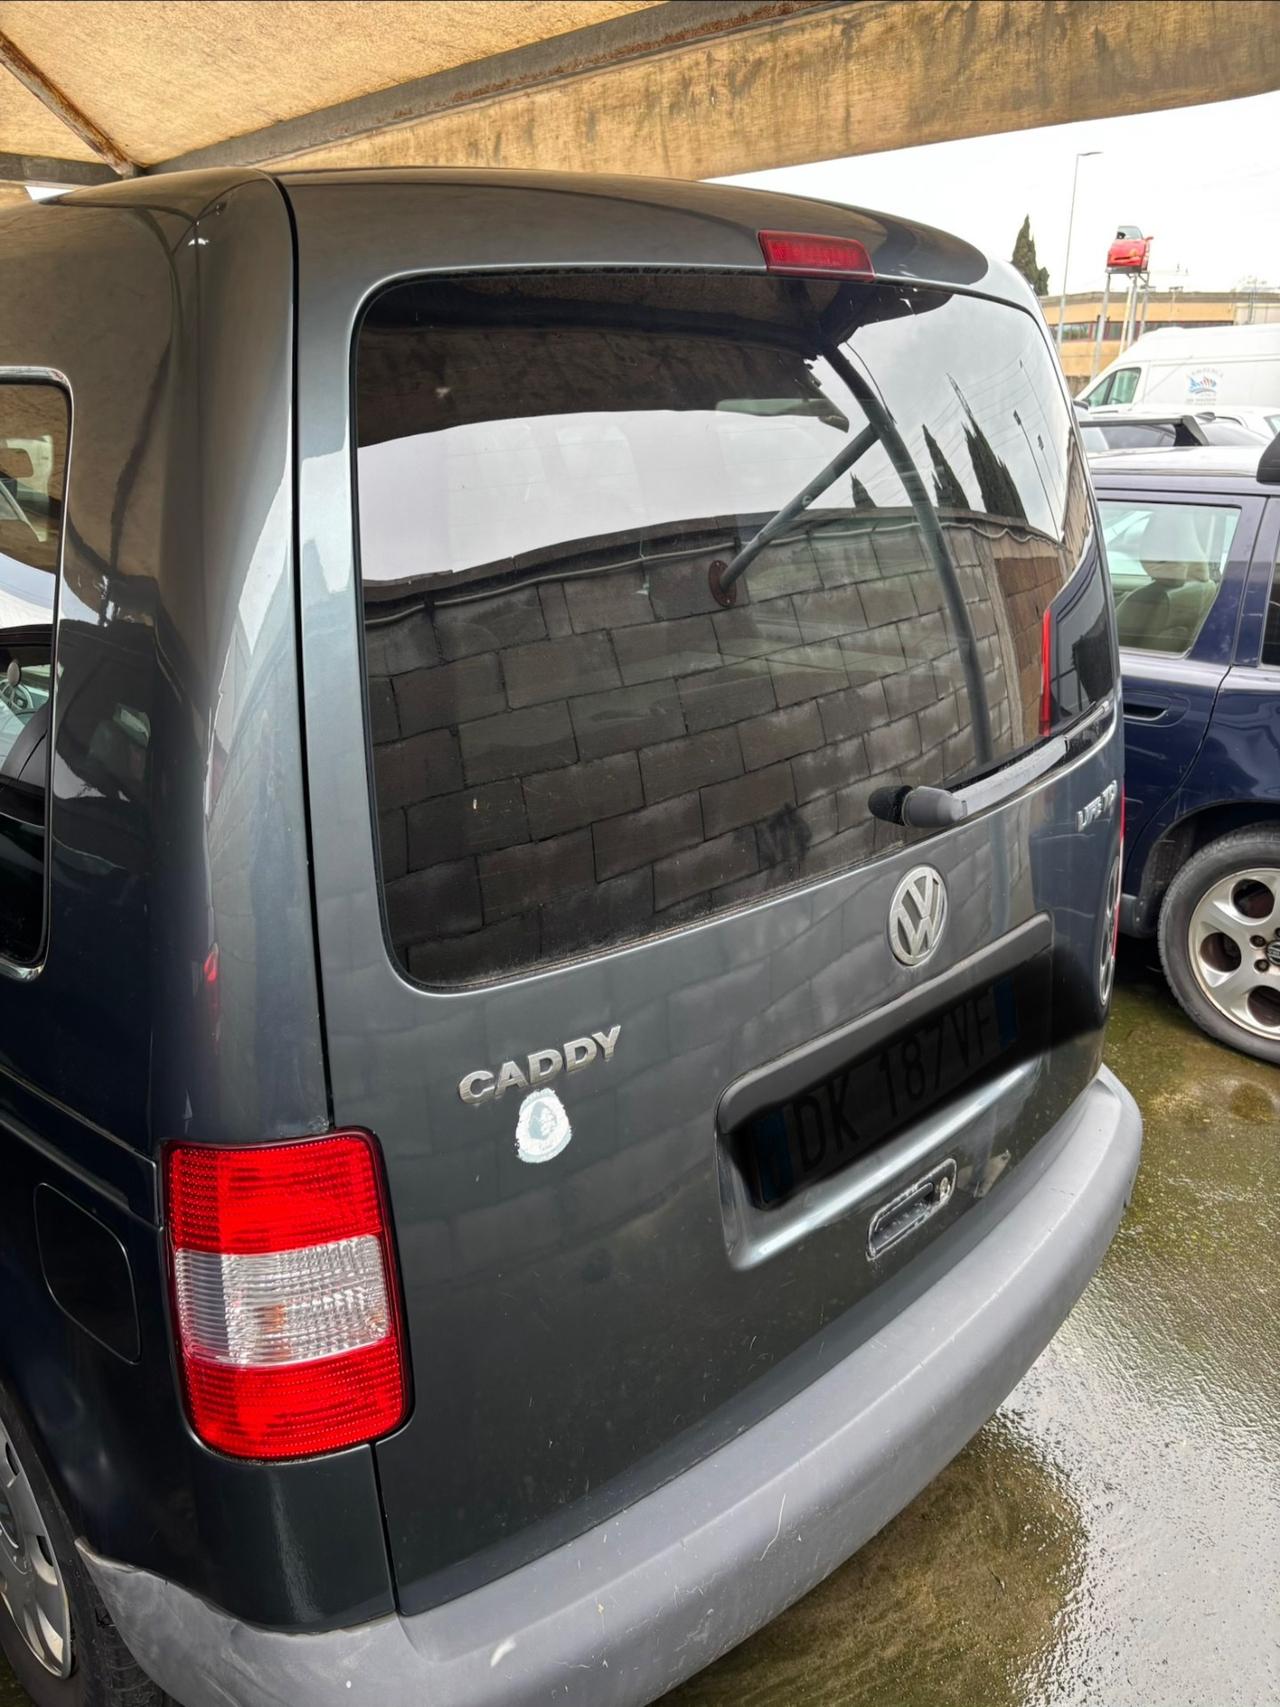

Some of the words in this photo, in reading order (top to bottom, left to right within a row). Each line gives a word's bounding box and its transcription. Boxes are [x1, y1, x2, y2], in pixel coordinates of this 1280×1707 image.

[889, 866, 948, 968] VW
[458, 1025, 621, 1104] CADDY
[792, 1073, 860, 1172] DK
[878, 994, 992, 1118] 187VF
